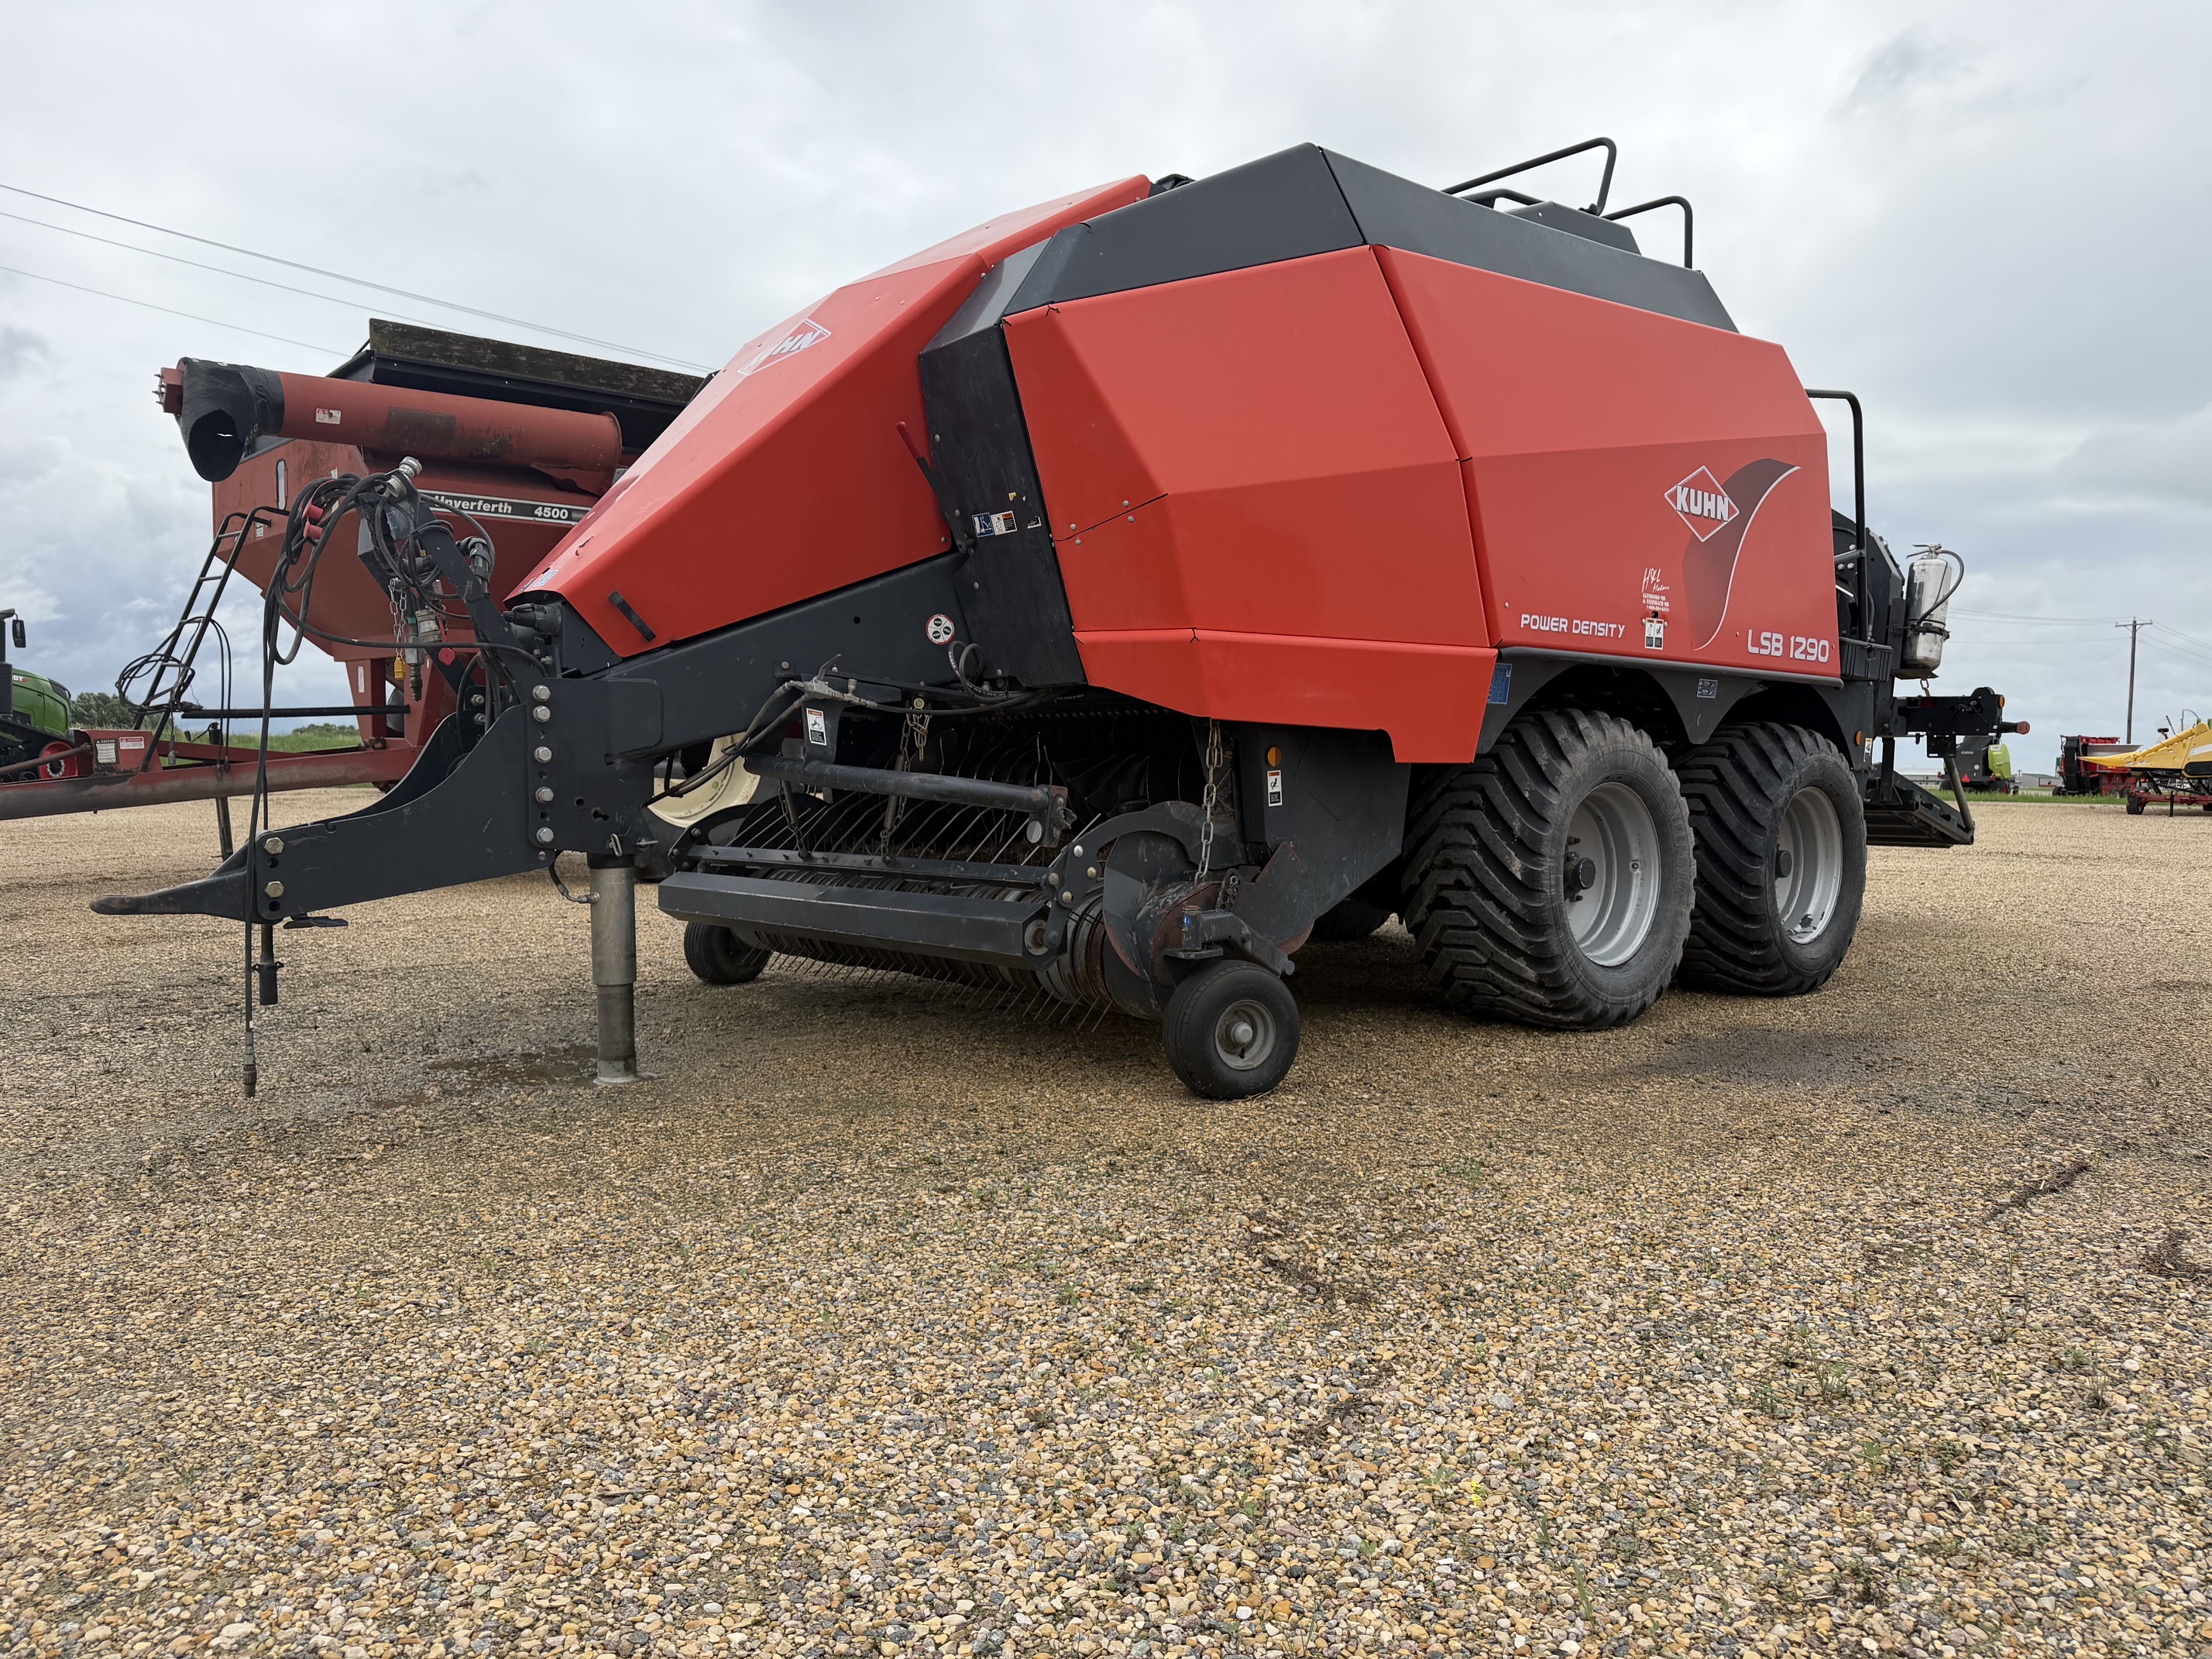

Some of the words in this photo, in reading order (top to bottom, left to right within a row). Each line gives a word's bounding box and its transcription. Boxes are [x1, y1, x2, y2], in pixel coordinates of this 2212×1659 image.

[534, 506, 568, 520] 4500
[1676, 485, 1729, 523] KUHN
[1520, 613, 1568, 633] POWER
[1571, 619, 1626, 638] DENSITY
[1747, 629, 1784, 657] LSB
[1789, 635, 1829, 663] 1290
